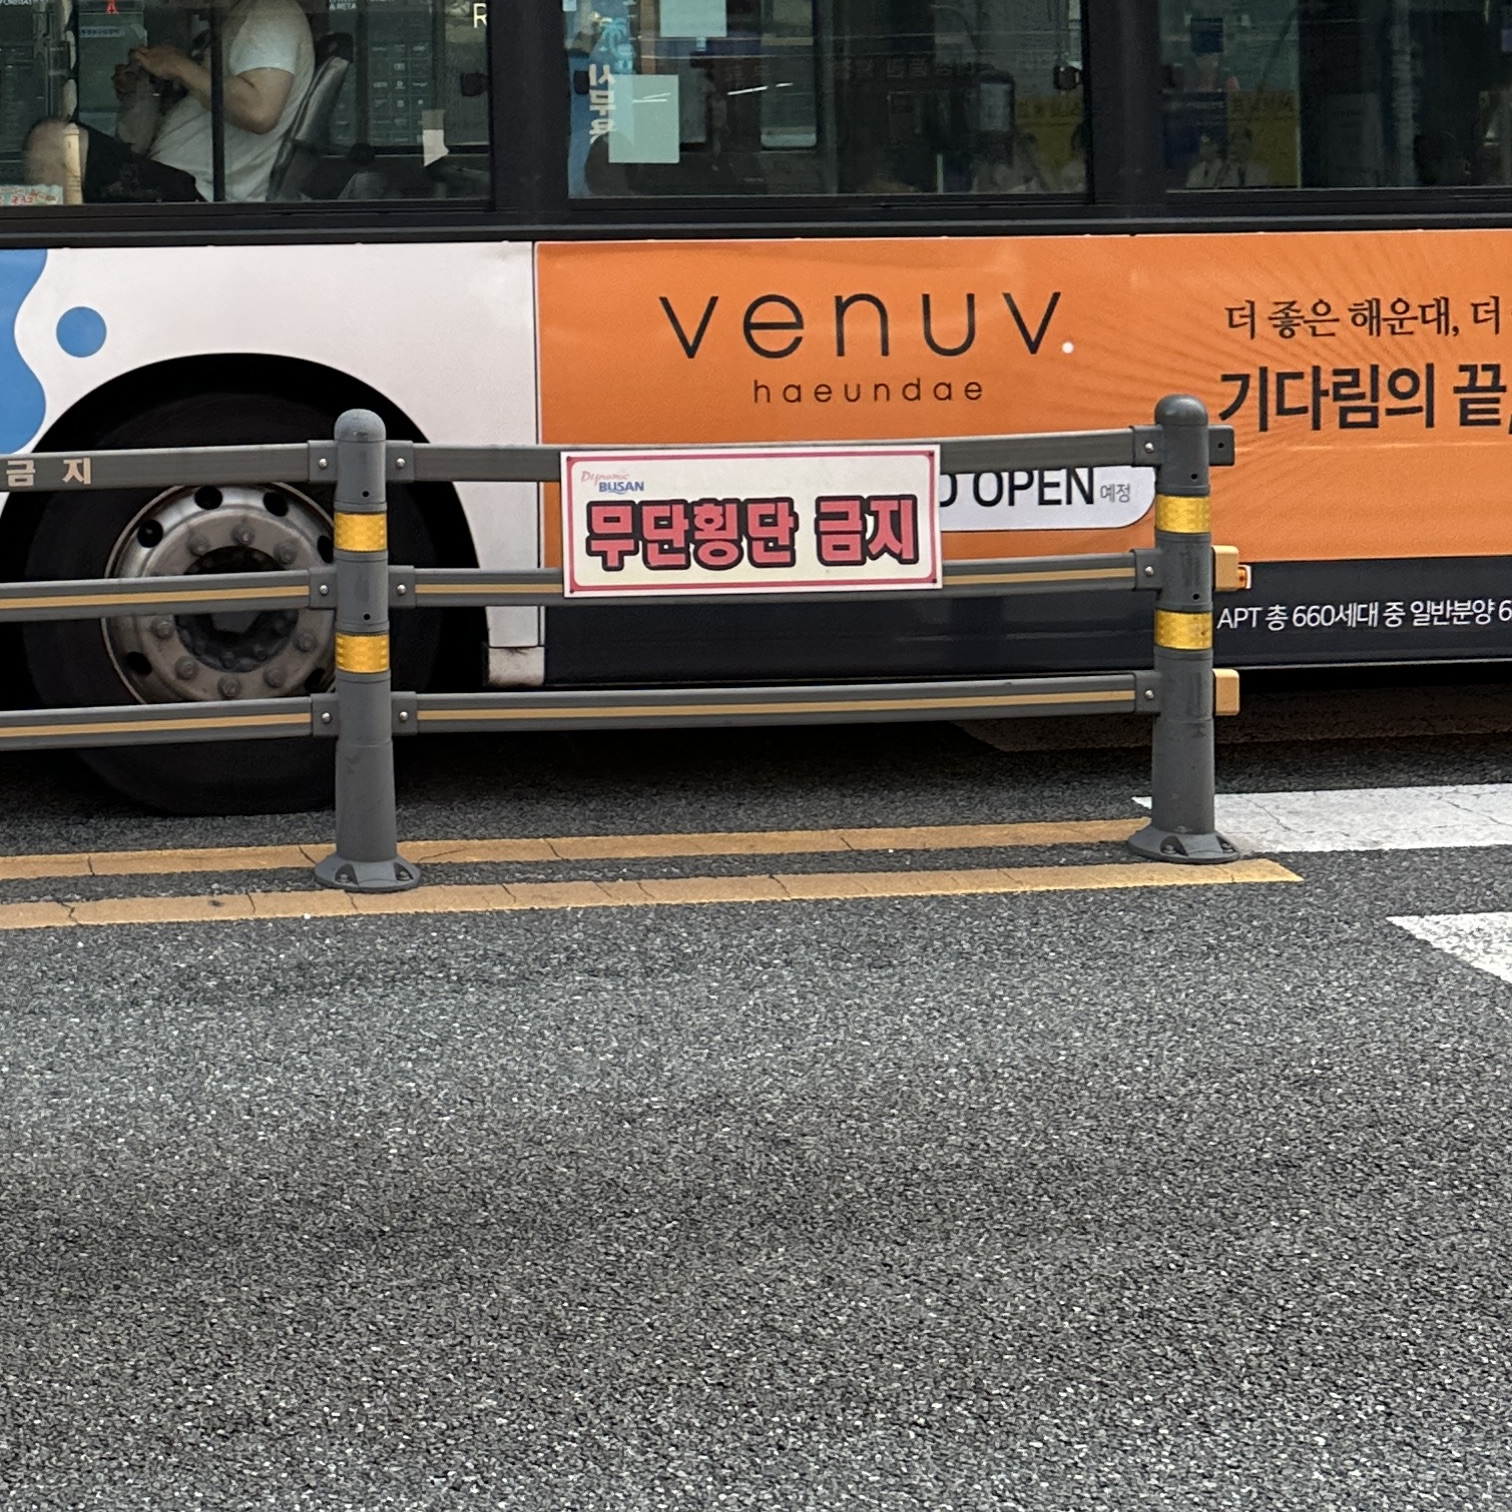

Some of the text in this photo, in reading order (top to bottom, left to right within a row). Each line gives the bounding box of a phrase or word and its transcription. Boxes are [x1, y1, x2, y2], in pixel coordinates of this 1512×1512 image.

[1224, 294, 1501, 340] 더 좋은 해운대, 더
[753, 377, 984, 404] haeundae
[1217, 362, 1435, 433] 기다림의
[598, 480, 645, 494] BUSAN
[973, 466, 1096, 508] OPEN
[1099, 483, 1132, 505] 예정
[585, 494, 921, 572] 무단횡단 금지
[1216, 606, 1263, 630] APT
[1264, 603, 1289, 632] 총
[1292, 601, 1379, 629] 660세대
[1383, 601, 1406, 628] 중
[1410, 598, 1495, 627] 일반분양
